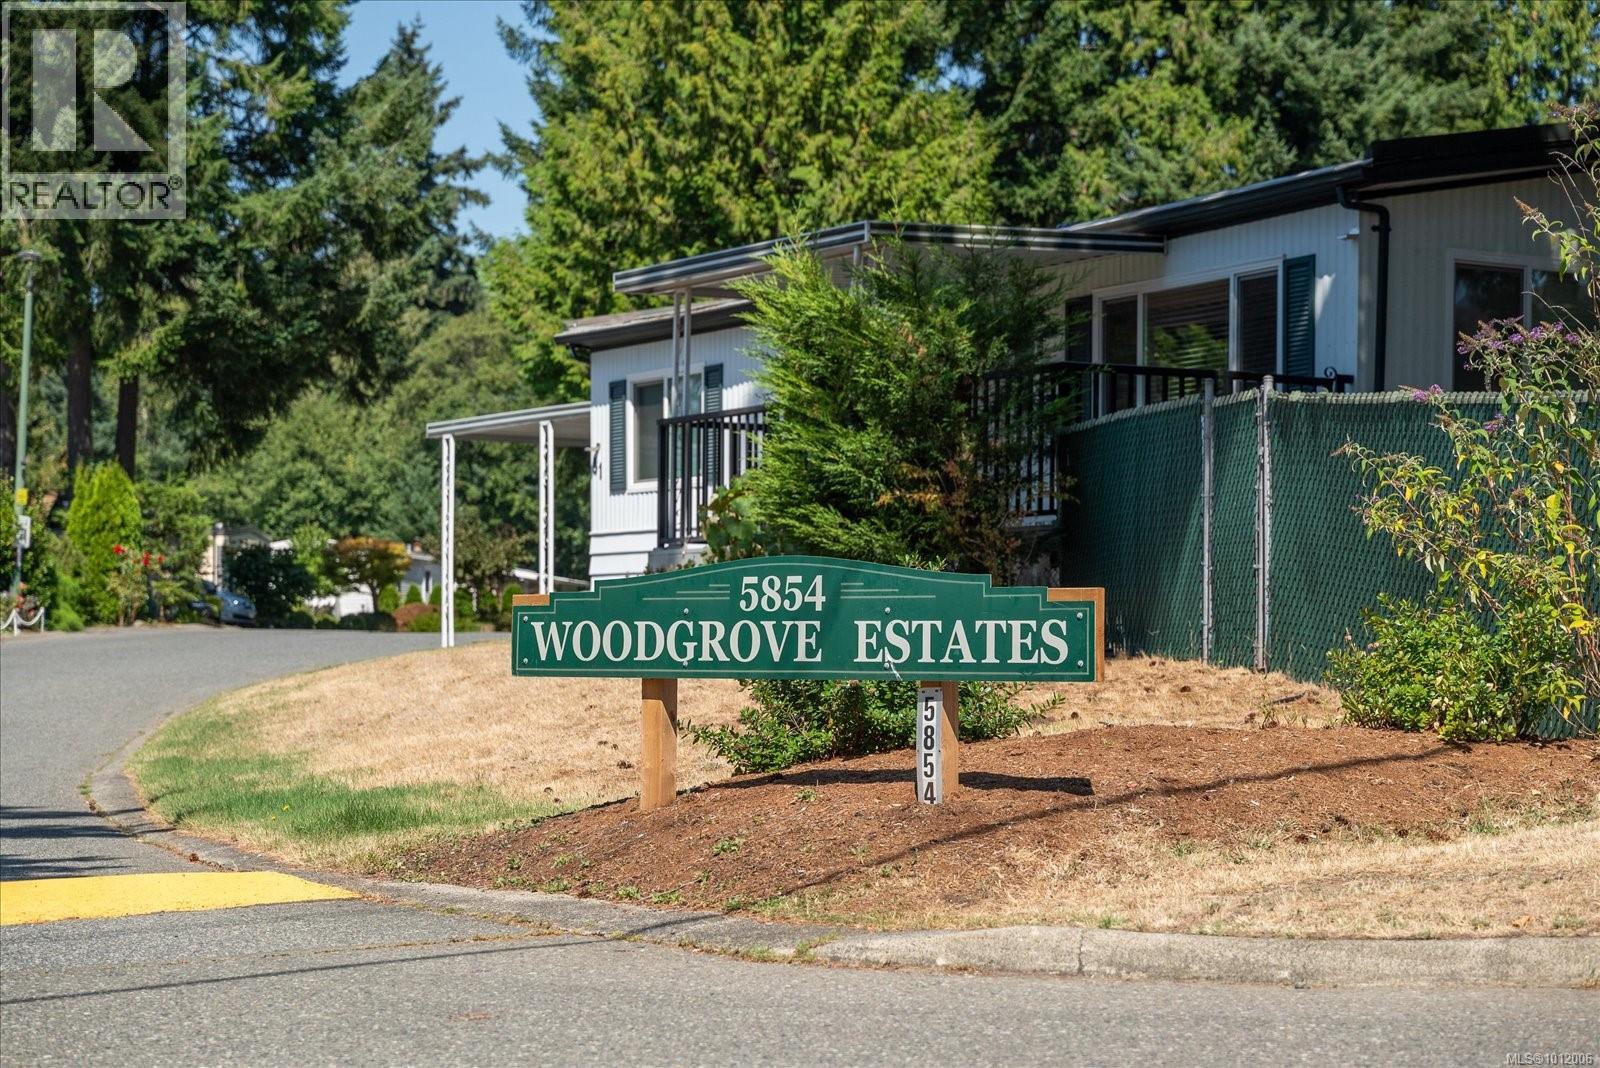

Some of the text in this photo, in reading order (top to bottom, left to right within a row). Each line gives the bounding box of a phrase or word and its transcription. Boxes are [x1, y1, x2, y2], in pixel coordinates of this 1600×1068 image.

[739, 575, 826, 612] 5854
[530, 619, 1069, 665] WOODGROVE ESTATES
[923, 696, 936, 804] 5854
